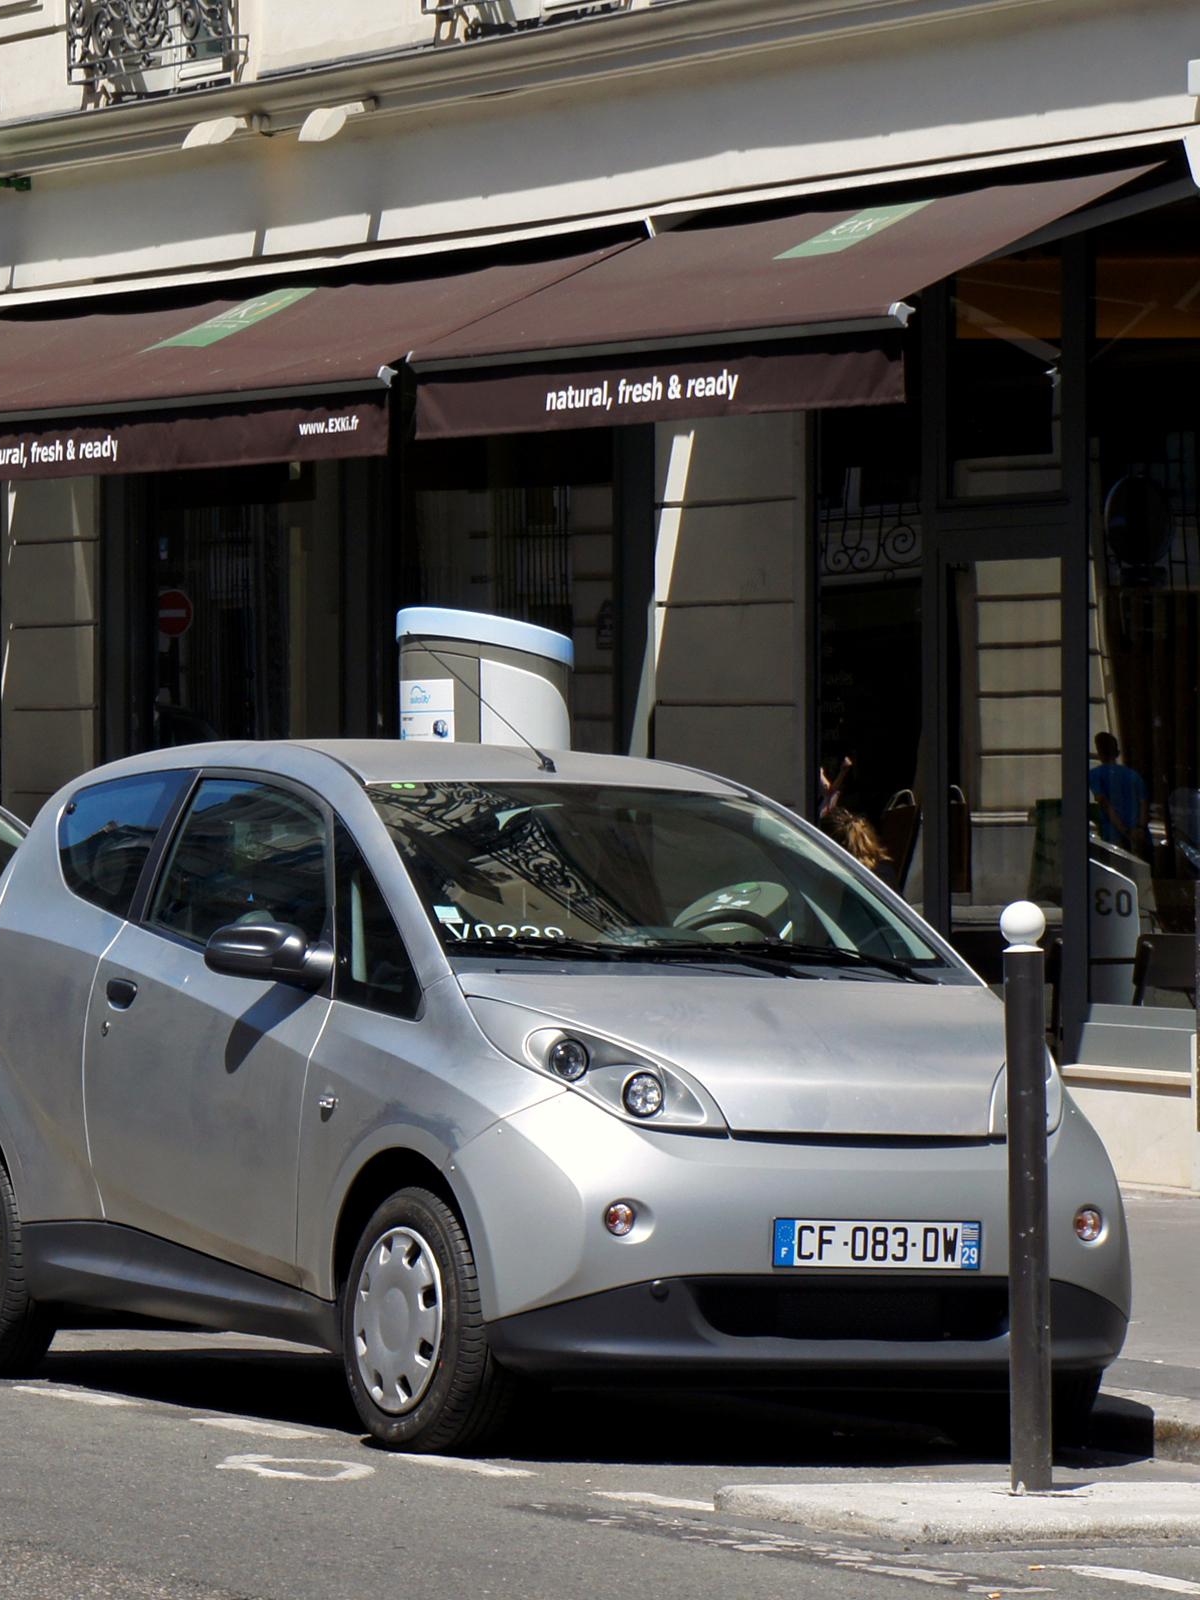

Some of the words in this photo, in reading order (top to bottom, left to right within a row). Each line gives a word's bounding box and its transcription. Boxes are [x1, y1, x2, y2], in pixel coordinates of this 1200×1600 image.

[545, 380, 613, 412] natural,
[617, 375, 663, 405] fresh
[667, 374, 682, 400] &
[686, 368, 739, 401] ready
[298, 415, 359, 436] www.EXKi.fr
[30, 440, 64, 463] fresh
[65, 439, 76, 461] &
[78, 434, 118, 462] ready
[780, 1247, 789, 1258] F
[961, 1247, 979, 1265] 29
